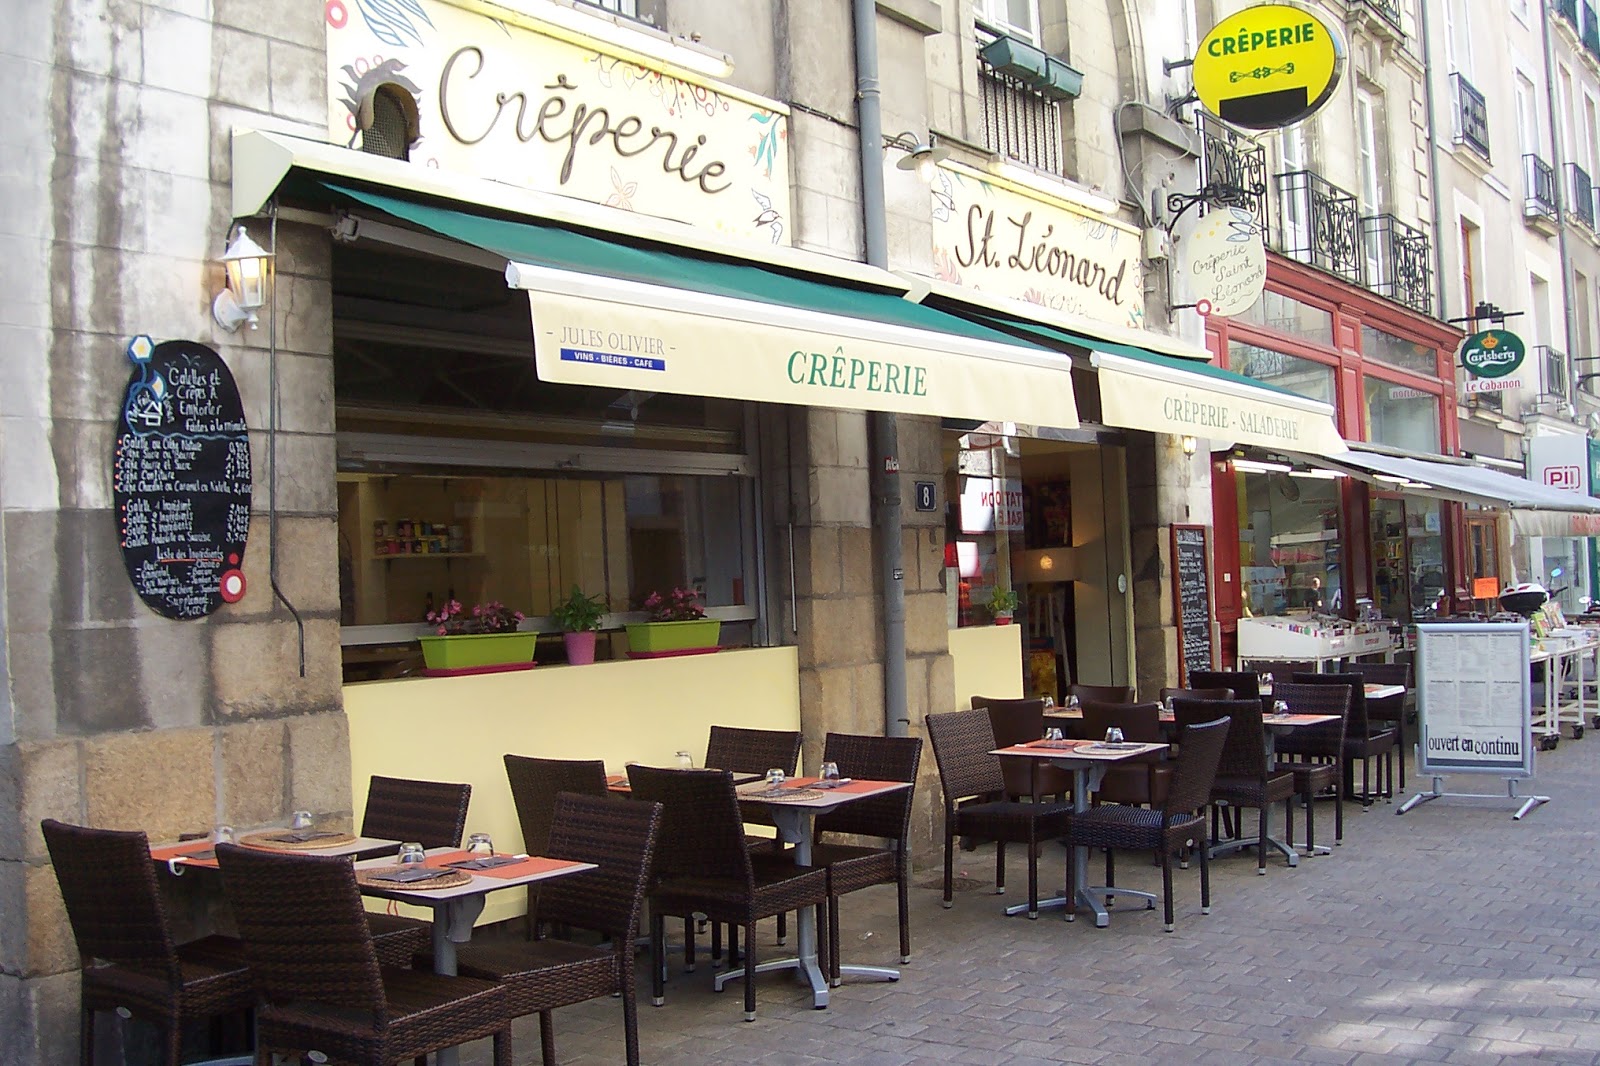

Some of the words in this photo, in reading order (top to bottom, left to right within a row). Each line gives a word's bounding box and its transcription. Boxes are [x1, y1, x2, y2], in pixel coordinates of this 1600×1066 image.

[1208, 23, 1314, 57] CRÊPERIE
[440, 46, 731, 193] Crêperie
[955, 204, 1000, 268] St.
[1007, 211, 1126, 306] Léonard
[1193, 245, 1247, 275] Crêperie
[1215, 256, 1254, 282] Saint
[1211, 265, 1264, 303] Léonard
[560, 326, 603, 347] JULES
[608, 332, 665, 355] OLIVIER
[574, 351, 594, 361] VINS
[601, 353, 628, 365] BIÈRES
[1466, 346, 1516, 366] Carlsberg
[786, 345, 928, 397] CRÊPERIE
[1466, 382, 1476, 392] Le
[1480, 379, 1520, 391] Cabanon
[1164, 393, 1229, 428] CRÊPERIE
[1240, 410, 1299, 440] SALADERIE
[923, 486, 930, 507] 8
[1428, 735, 1459, 752] ouvert
[1461, 738, 1474, 752] en
[1474, 736, 1519, 755] continu
